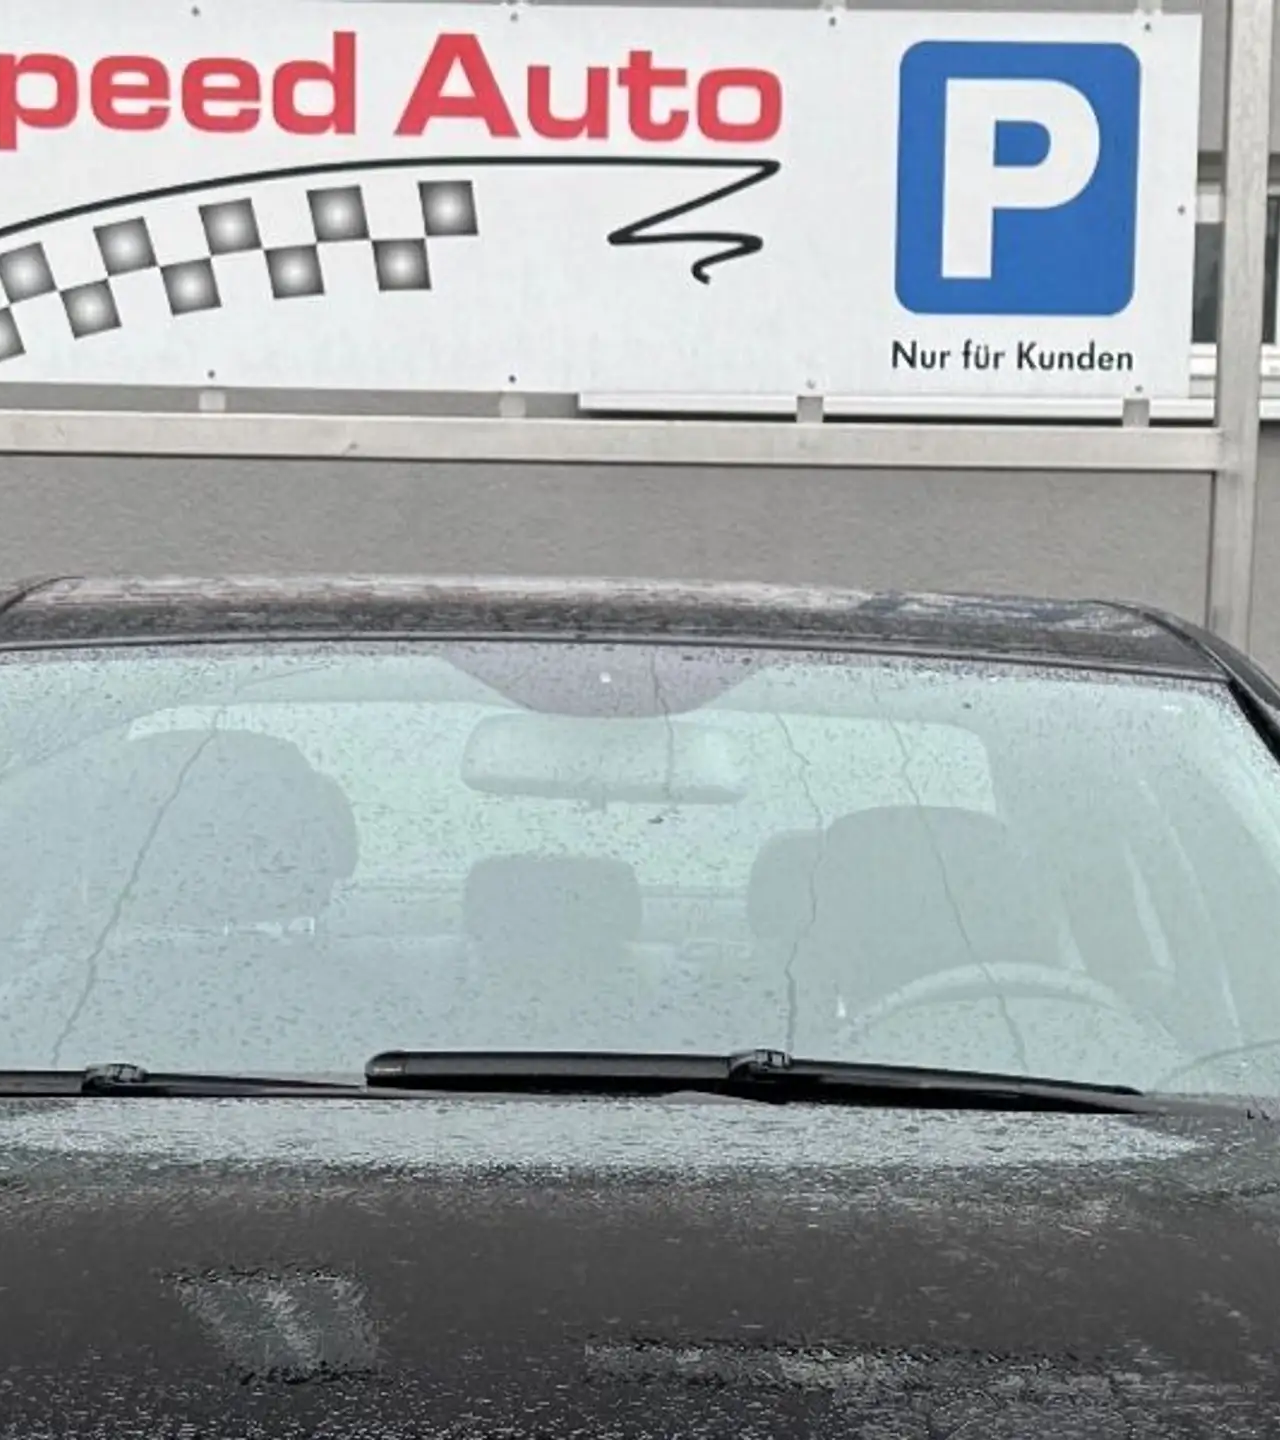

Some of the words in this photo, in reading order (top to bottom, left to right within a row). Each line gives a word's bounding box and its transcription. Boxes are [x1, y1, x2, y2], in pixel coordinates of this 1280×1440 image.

[393, 32, 783, 143] Auto
[941, 78, 1101, 279] P
[891, 340, 952, 371] Nur
[961, 338, 1006, 371] für
[1016, 341, 1134, 373] Kunden
